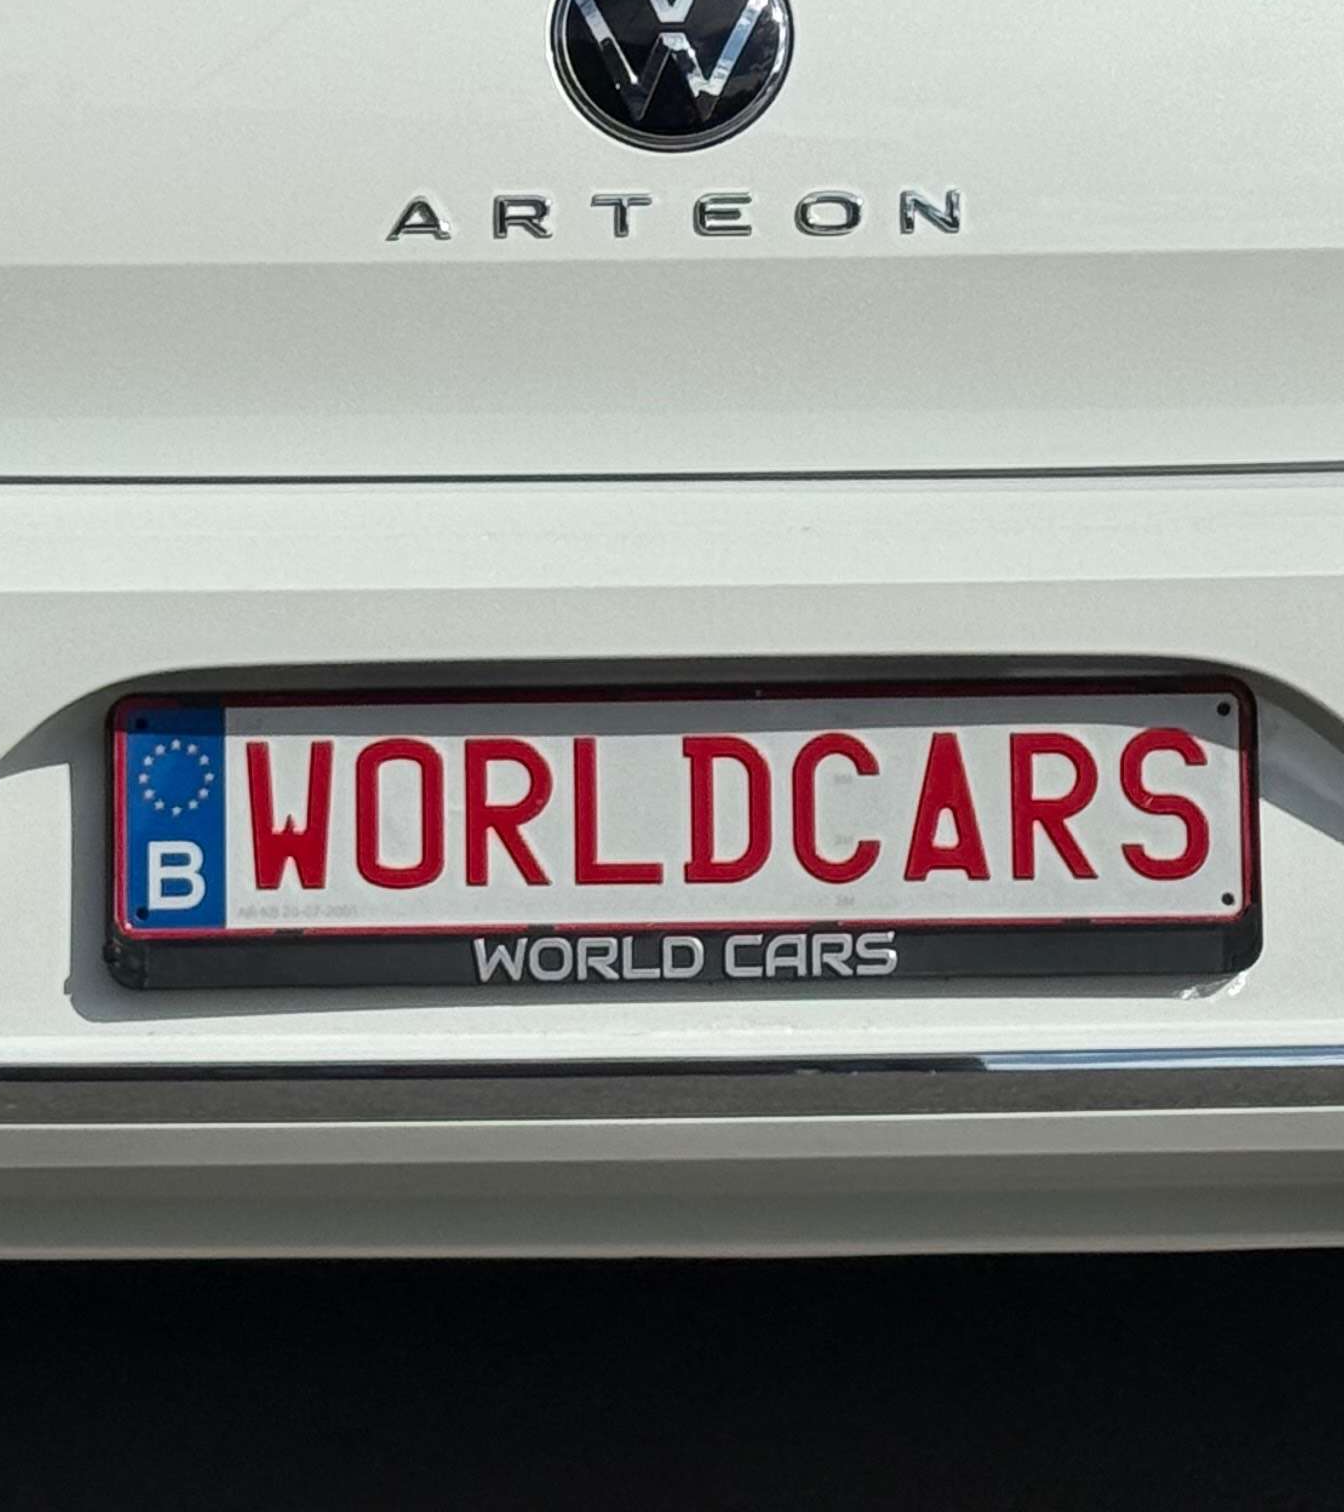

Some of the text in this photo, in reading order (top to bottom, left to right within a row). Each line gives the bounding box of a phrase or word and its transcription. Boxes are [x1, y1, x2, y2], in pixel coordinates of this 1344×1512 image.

[386, 189, 961, 242] ARTEON
[148, 727, 1209, 911] B WORLDCARS
[473, 931, 898, 982] WORLD CARS
